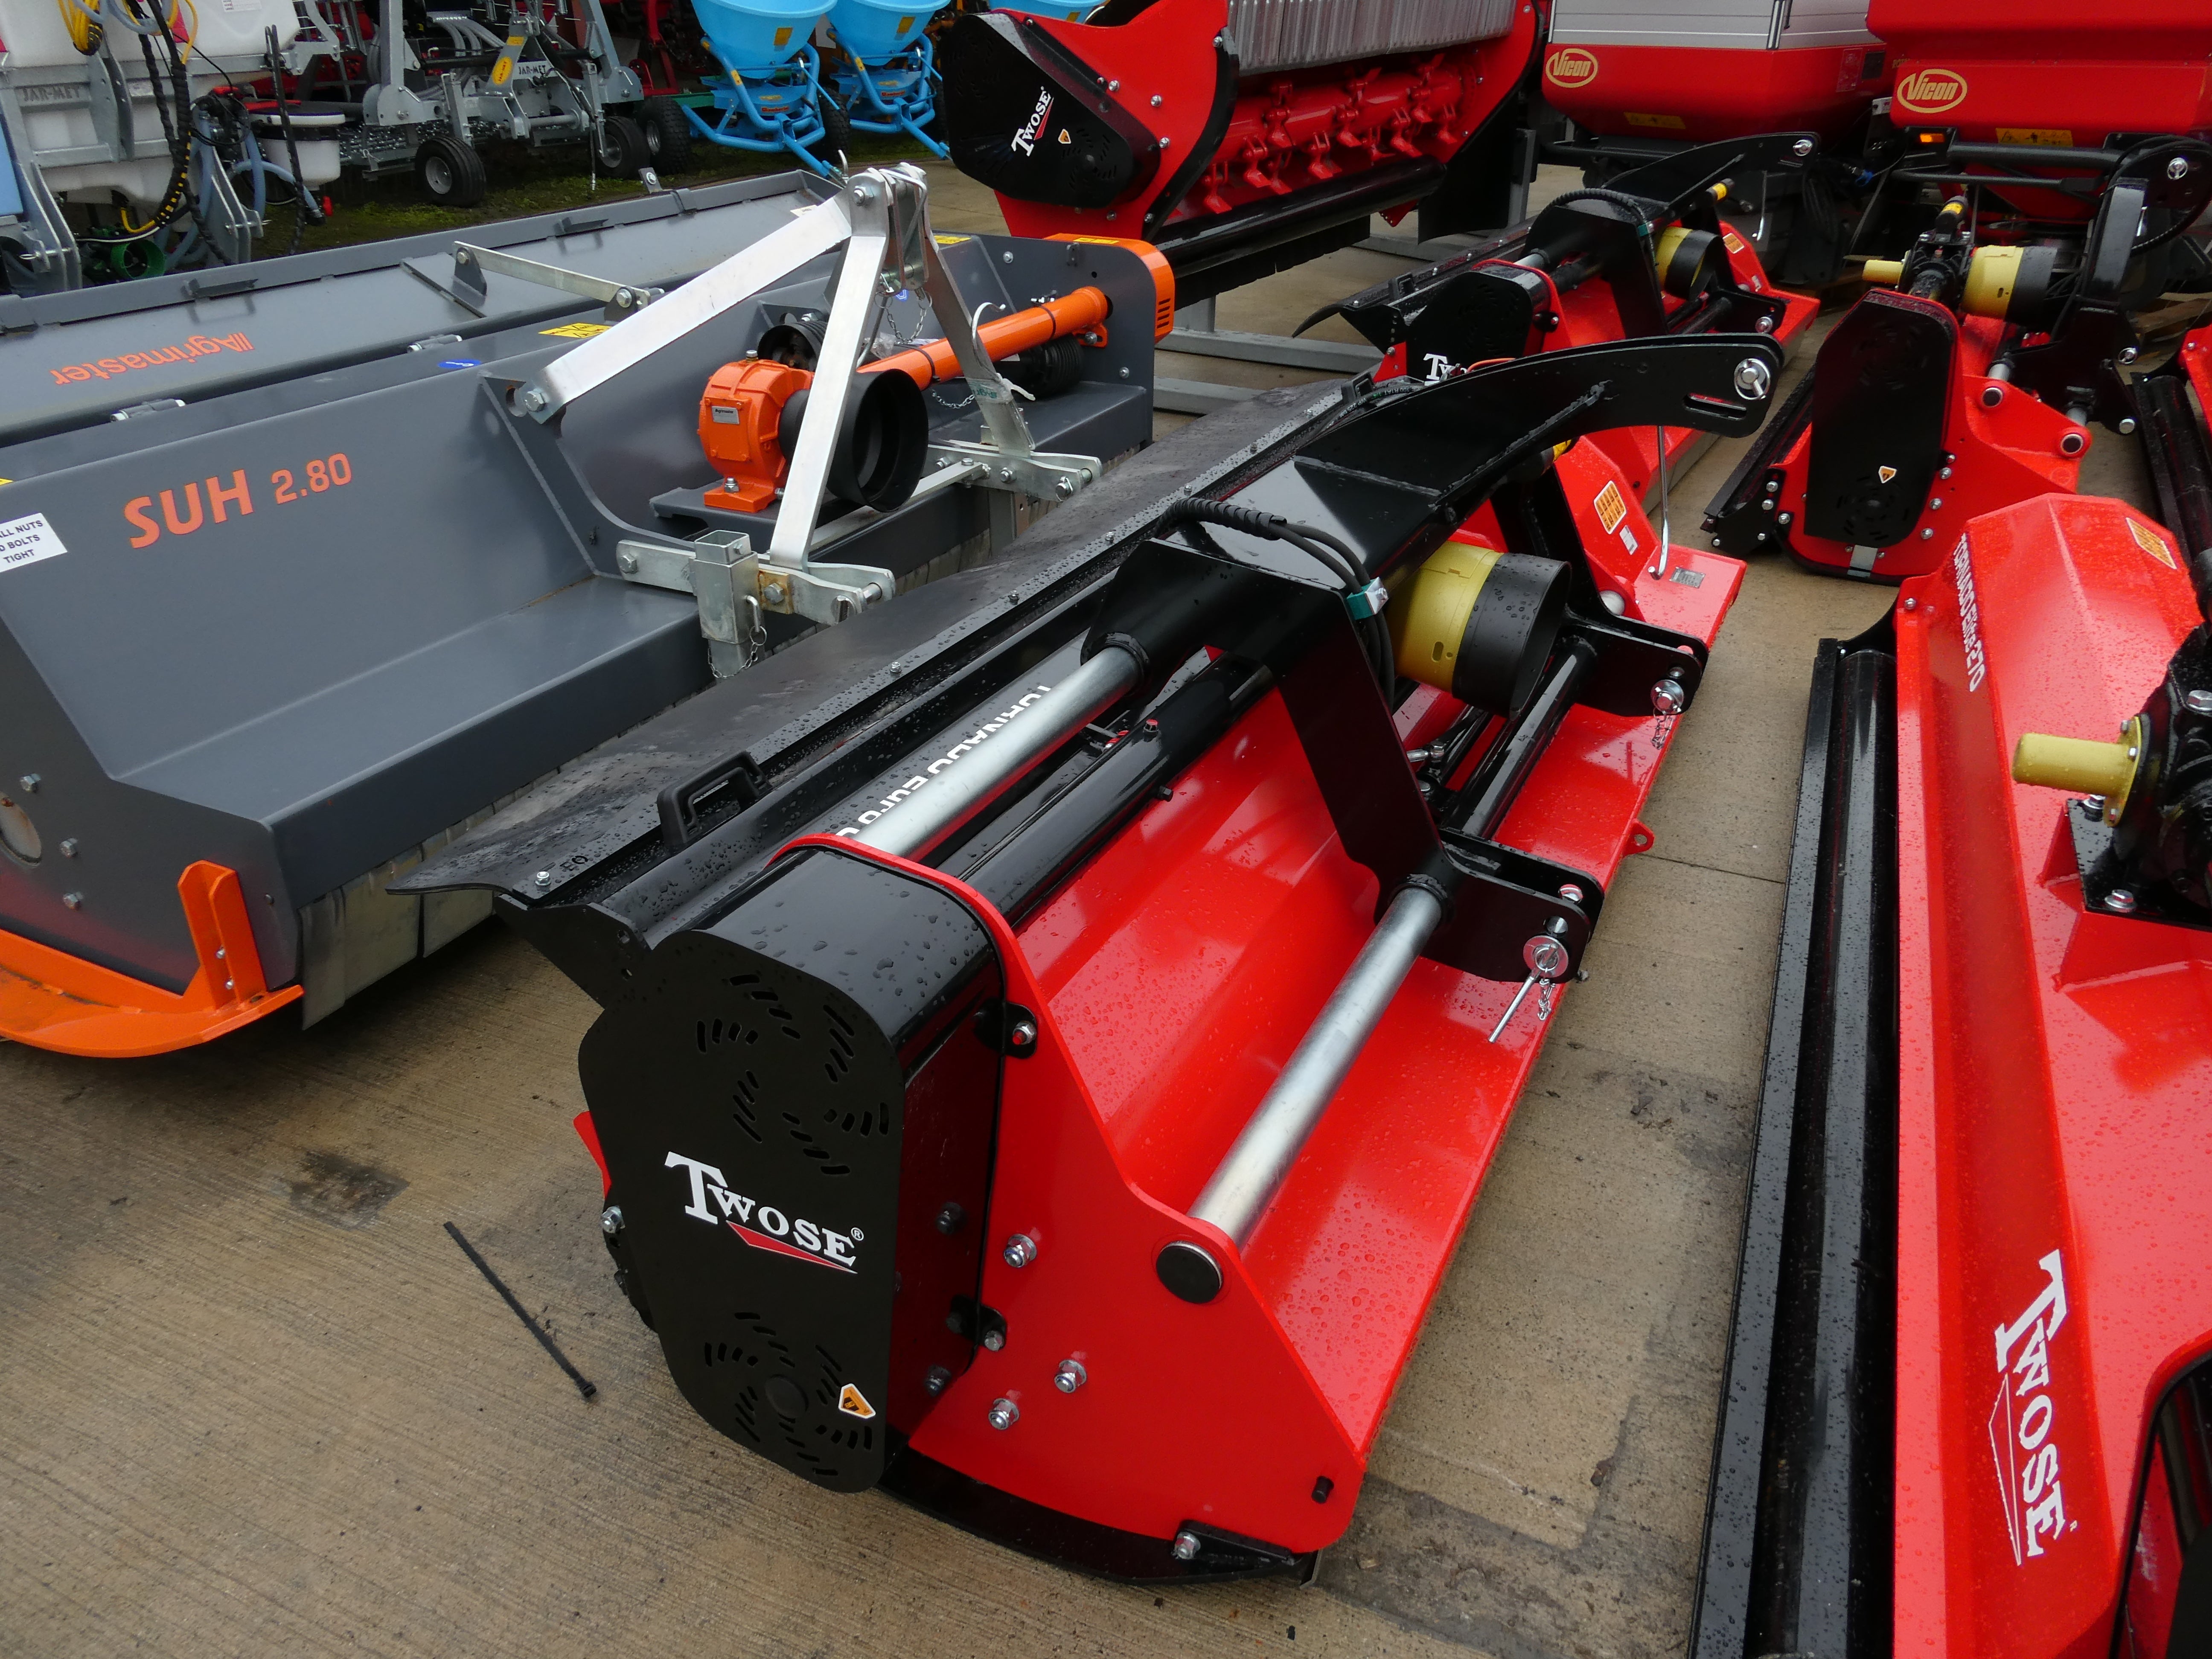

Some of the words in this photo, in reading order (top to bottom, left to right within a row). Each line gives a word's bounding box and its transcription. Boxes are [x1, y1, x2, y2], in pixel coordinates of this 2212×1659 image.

[518, 65, 546, 75] JAR-MET
[1551, 51, 1593, 78] Vicon
[1905, 72, 1960, 102] Vicon
[49, 332, 255, 384] Agrimaster
[124, 469, 253, 549] SUH
[271, 453, 352, 504] 2.80
[15, 520, 43, 533] NUTS
[7, 534, 40, 549] BOLTS
[3, 549, 34, 563] TIGHT
[1953, 532, 1976, 617] TORNADO
[1966, 640, 1985, 692] 270
